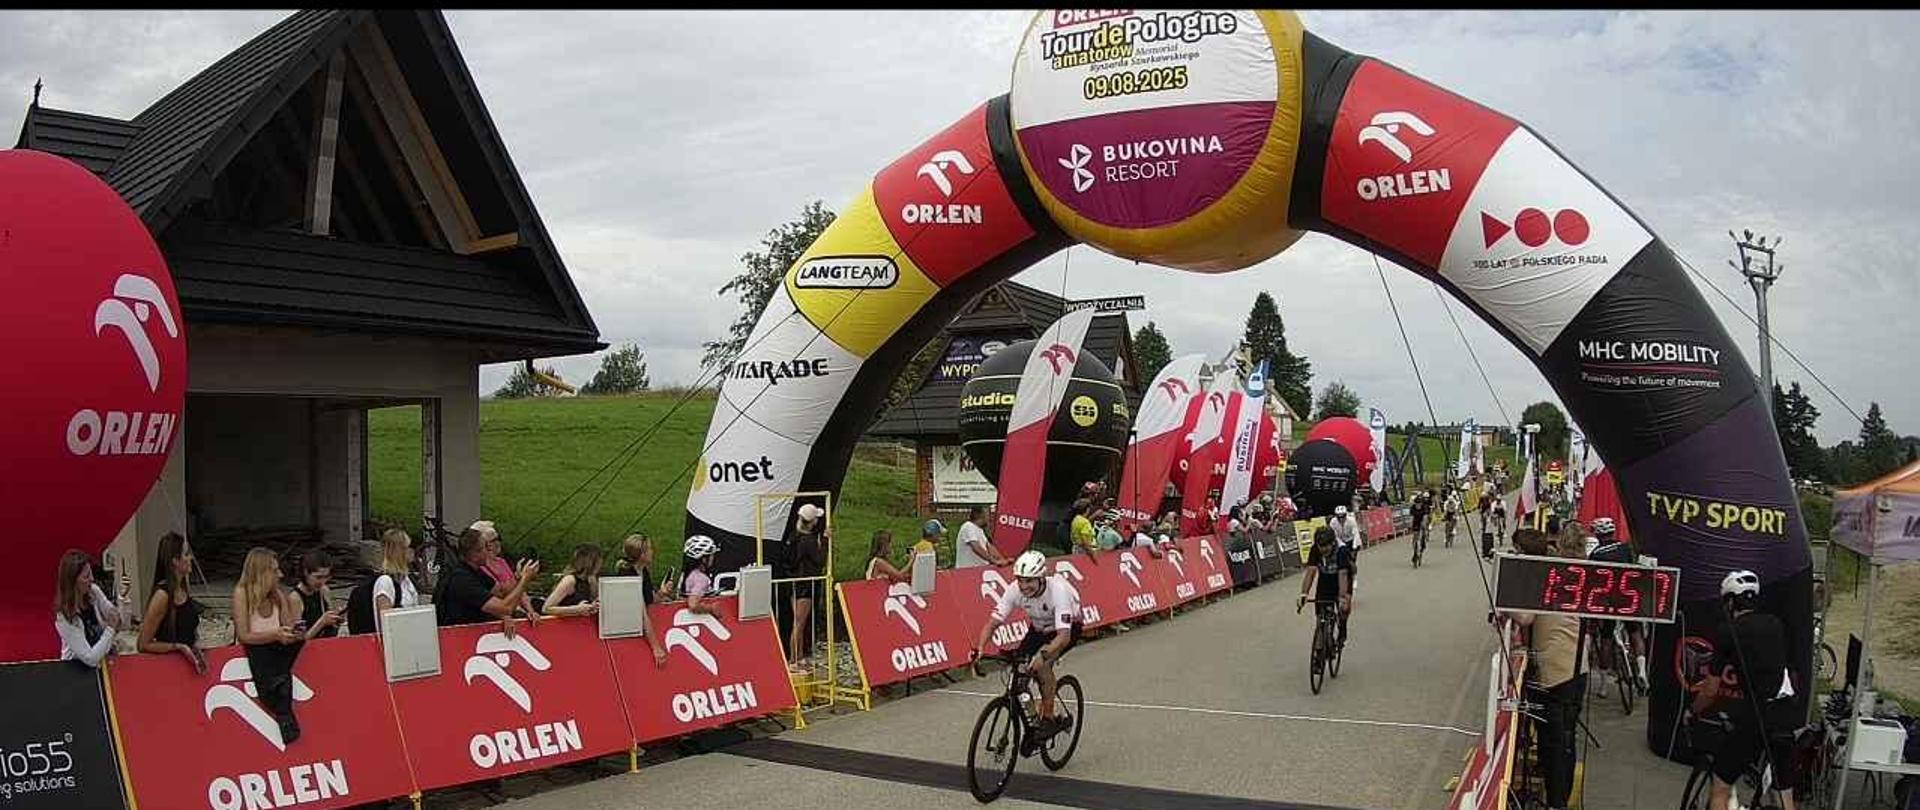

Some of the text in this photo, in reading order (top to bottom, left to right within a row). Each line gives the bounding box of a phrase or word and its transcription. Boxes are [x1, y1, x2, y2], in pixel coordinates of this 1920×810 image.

[1083, 65, 1188, 100] 09.08.2025
[1103, 135, 1223, 162] BUKOVINA
[1105, 160, 1178, 182] RESORT
[1357, 168, 1451, 200] ORLEN
[901, 203, 982, 224] ORLEN
[1578, 340, 1720, 366] MHC MOBILITY
[1622, 376, 1637, 384] the
[1639, 376, 1665, 386] future
[1666, 377, 1676, 386] of
[67, 409, 176, 456] ORLEN
[710, 456, 774, 482] onet
[1000, 515, 1035, 530] ORLEN
[1647, 491, 1786, 535] TVP SPORT
[1127, 592, 1157, 612] ORLEN
[891, 641, 948, 672] ORLEN
[672, 682, 757, 723] ORLEN
[468, 719, 583, 769] ORLEN
[15, 776, 76, 793] solutions
[208, 760, 349, 810] ORLEN
